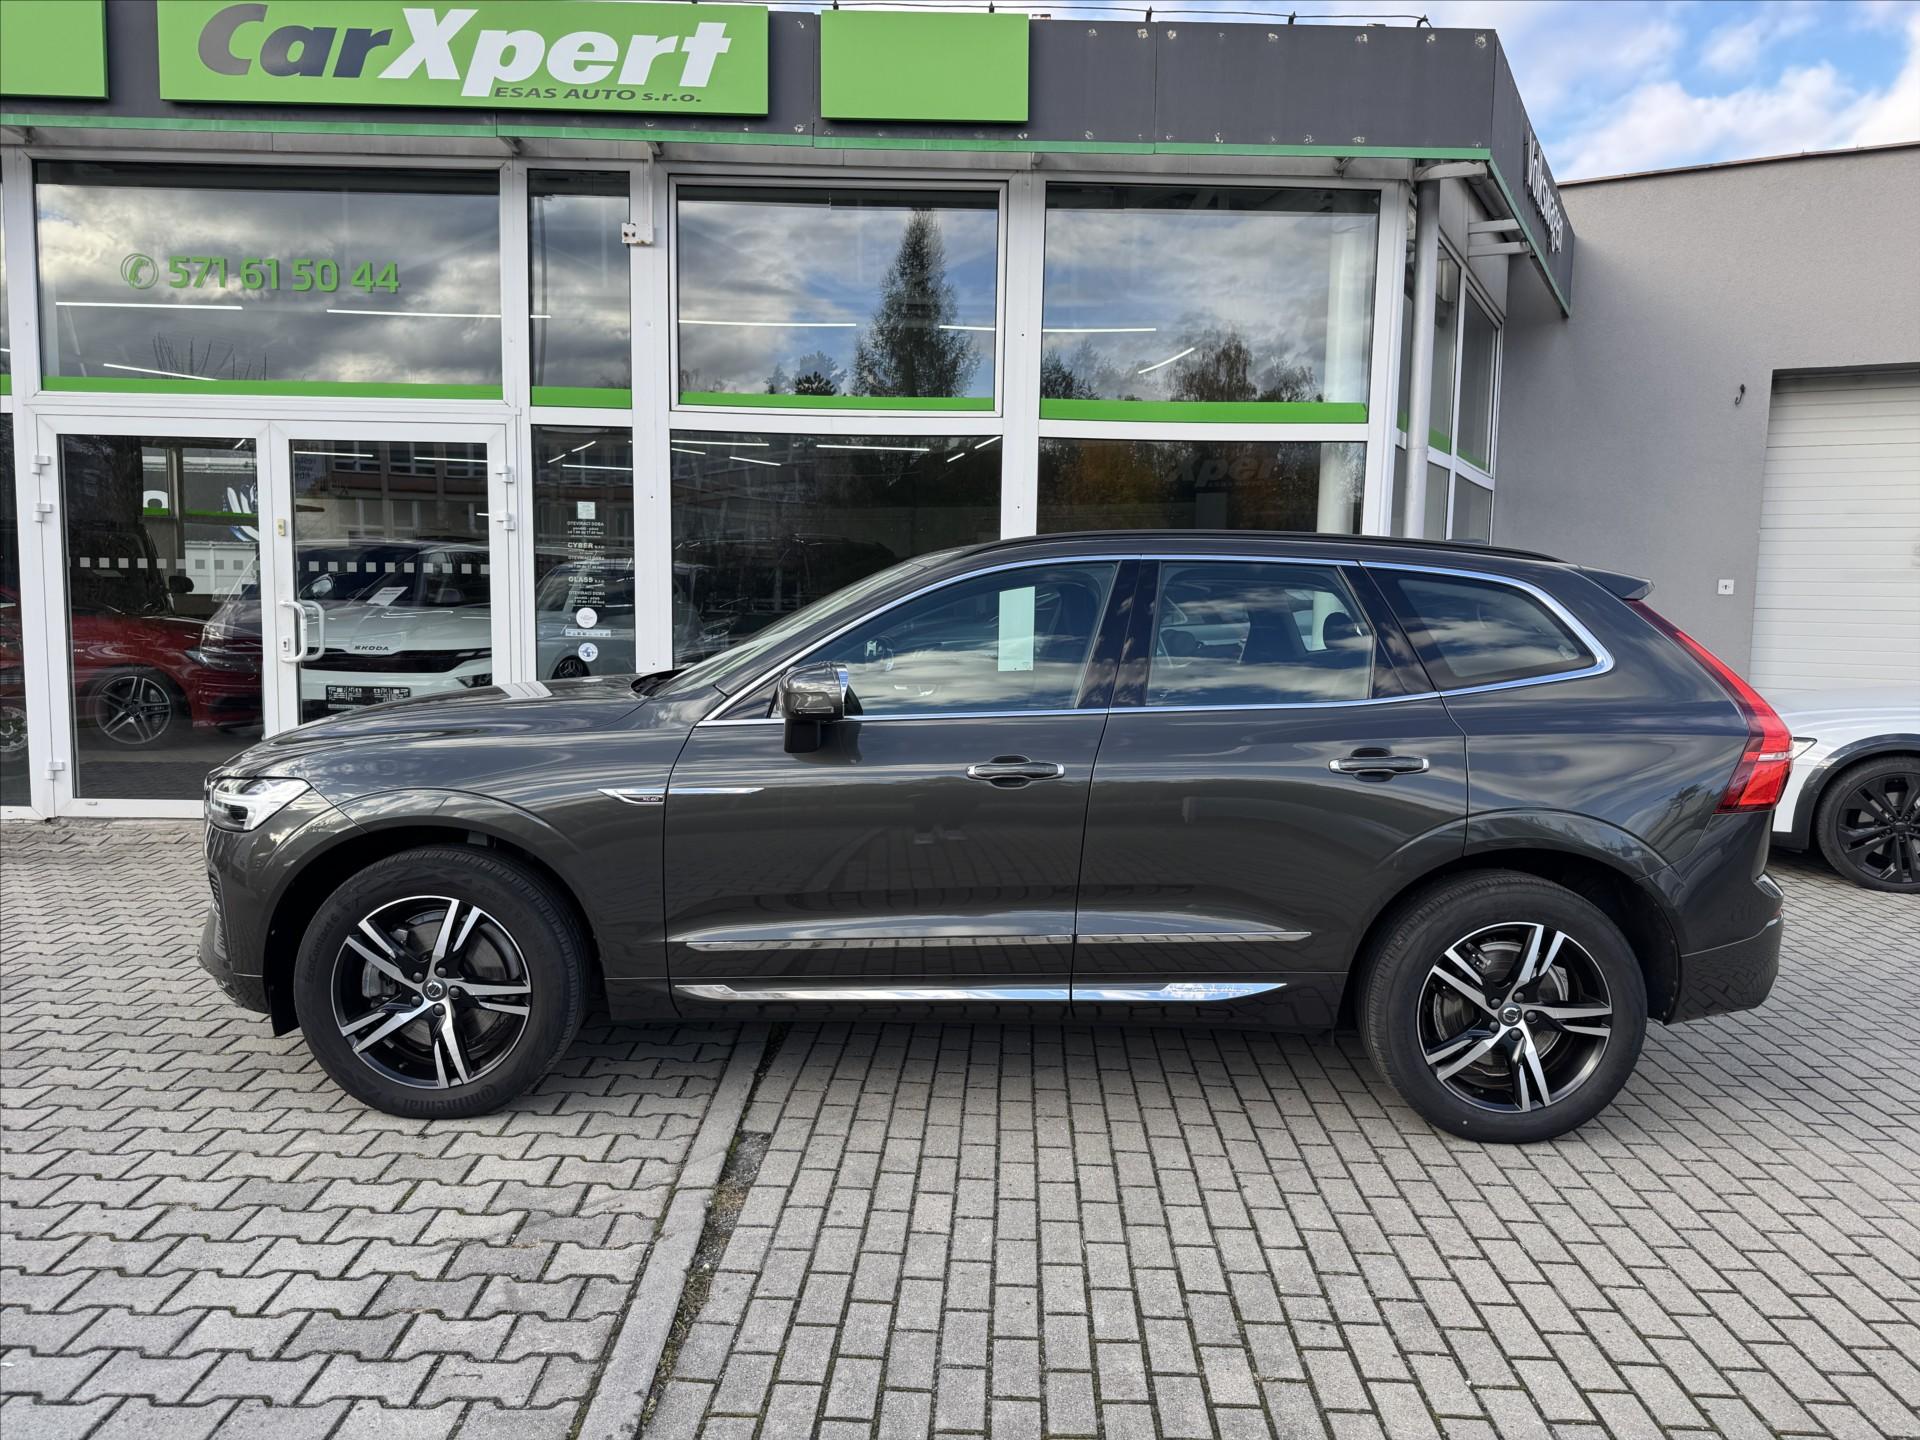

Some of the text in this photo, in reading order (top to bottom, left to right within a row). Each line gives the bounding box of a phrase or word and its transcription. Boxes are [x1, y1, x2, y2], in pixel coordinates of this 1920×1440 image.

[197, 3, 732, 97] CarXpert
[494, 87, 702, 102] ESAS AUTO s.r.o.
[168, 255, 400, 295] 571 61 50 44
